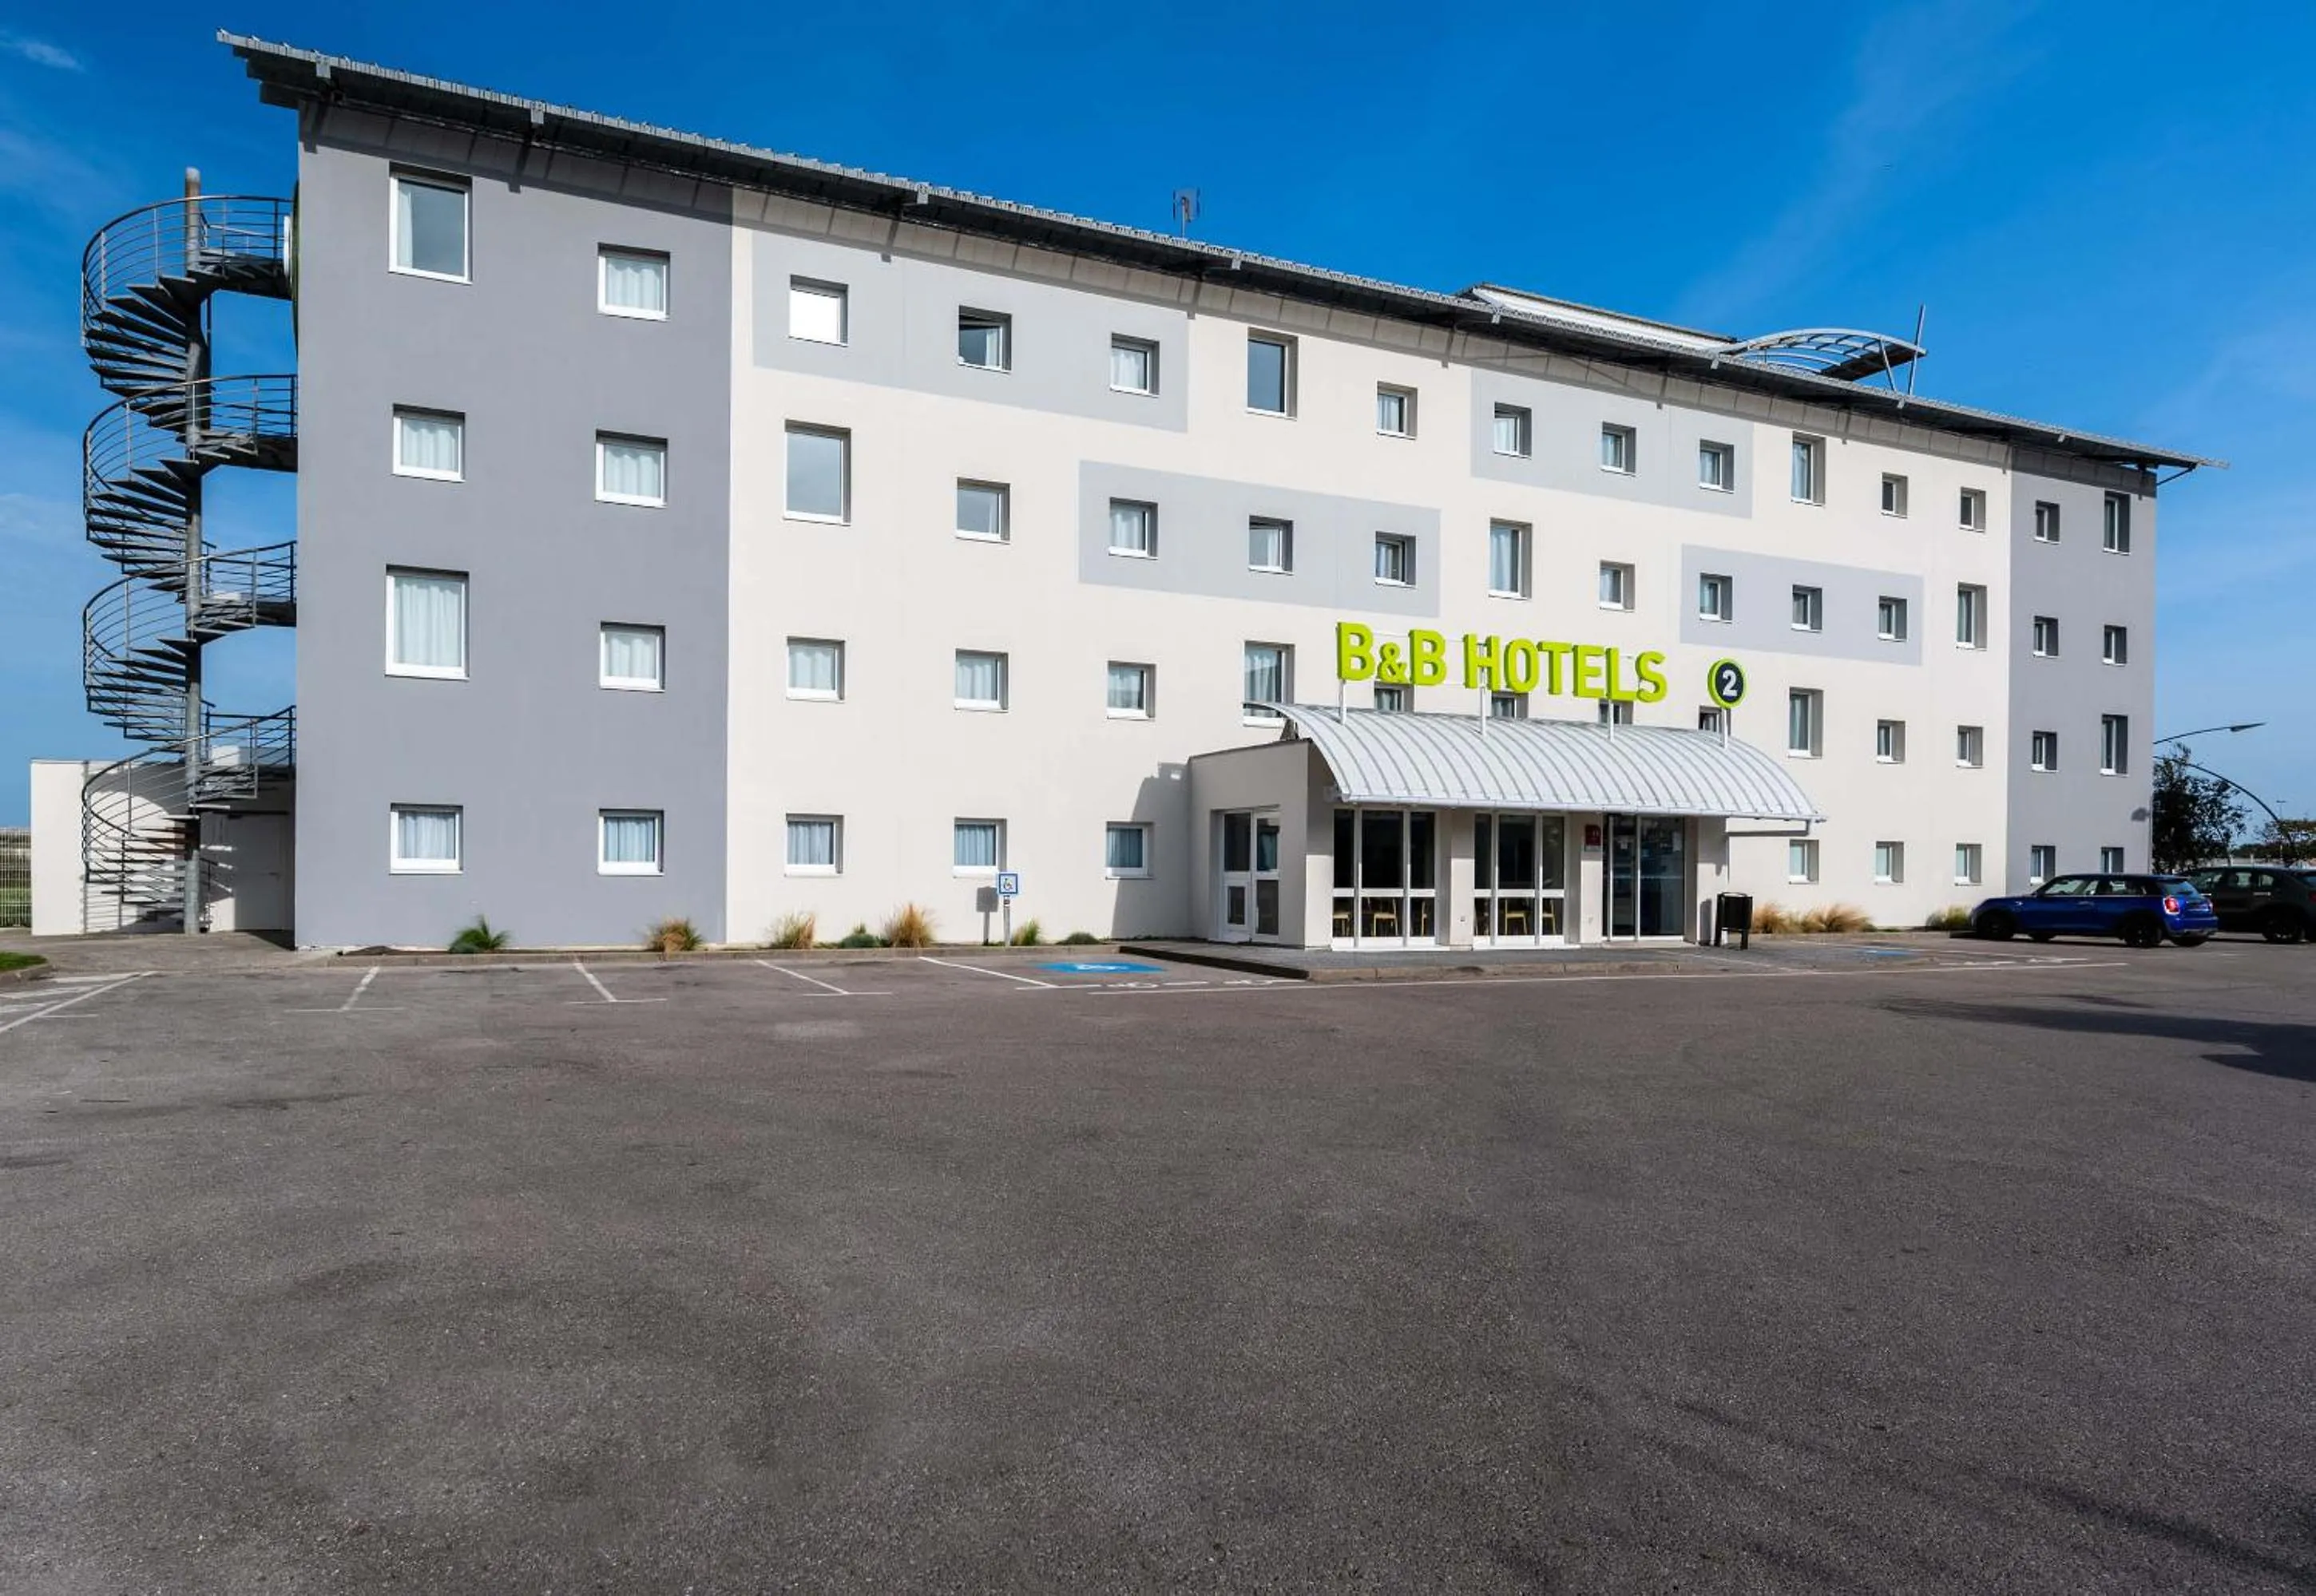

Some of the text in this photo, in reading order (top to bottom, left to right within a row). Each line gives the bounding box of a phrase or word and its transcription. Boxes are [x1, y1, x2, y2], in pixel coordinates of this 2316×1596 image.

[1337, 621, 1668, 703] B&B HOTELS
[1722, 669, 1738, 696] 2
